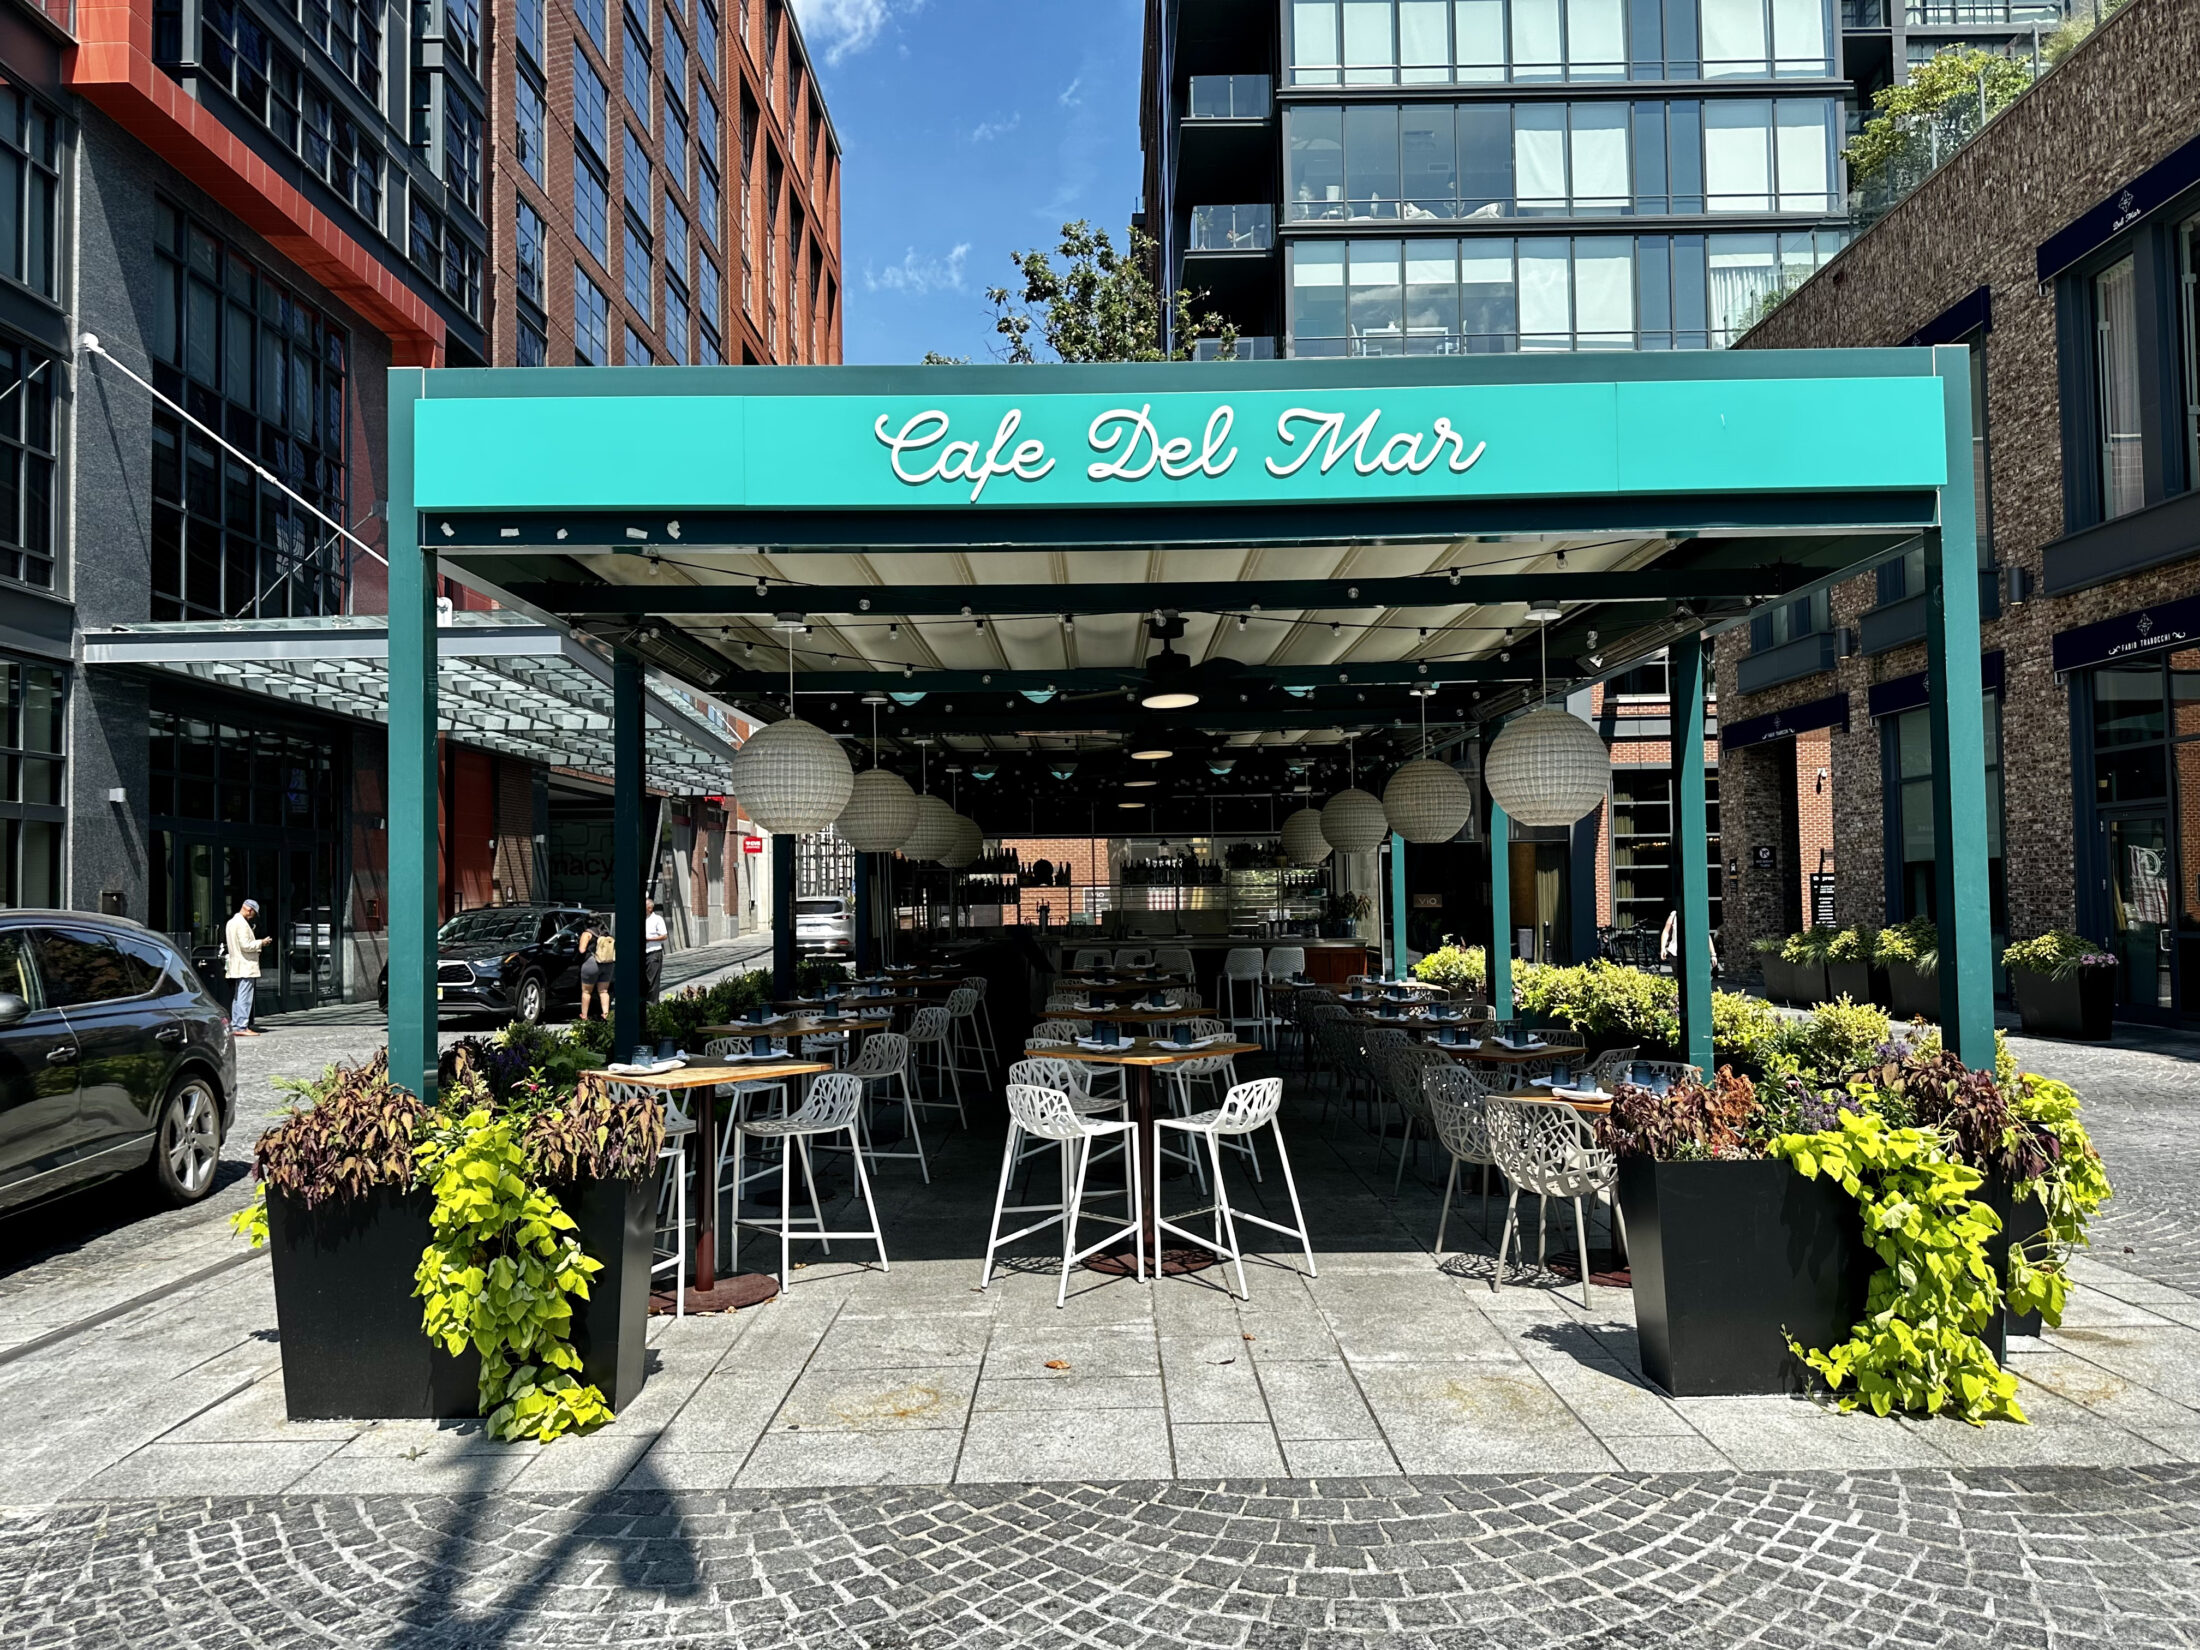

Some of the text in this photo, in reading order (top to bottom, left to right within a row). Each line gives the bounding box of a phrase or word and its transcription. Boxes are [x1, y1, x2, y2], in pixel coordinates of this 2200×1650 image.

[874, 403, 1487, 503] Cafe Del Mar
[2121, 641, 2137, 651] FABIO
